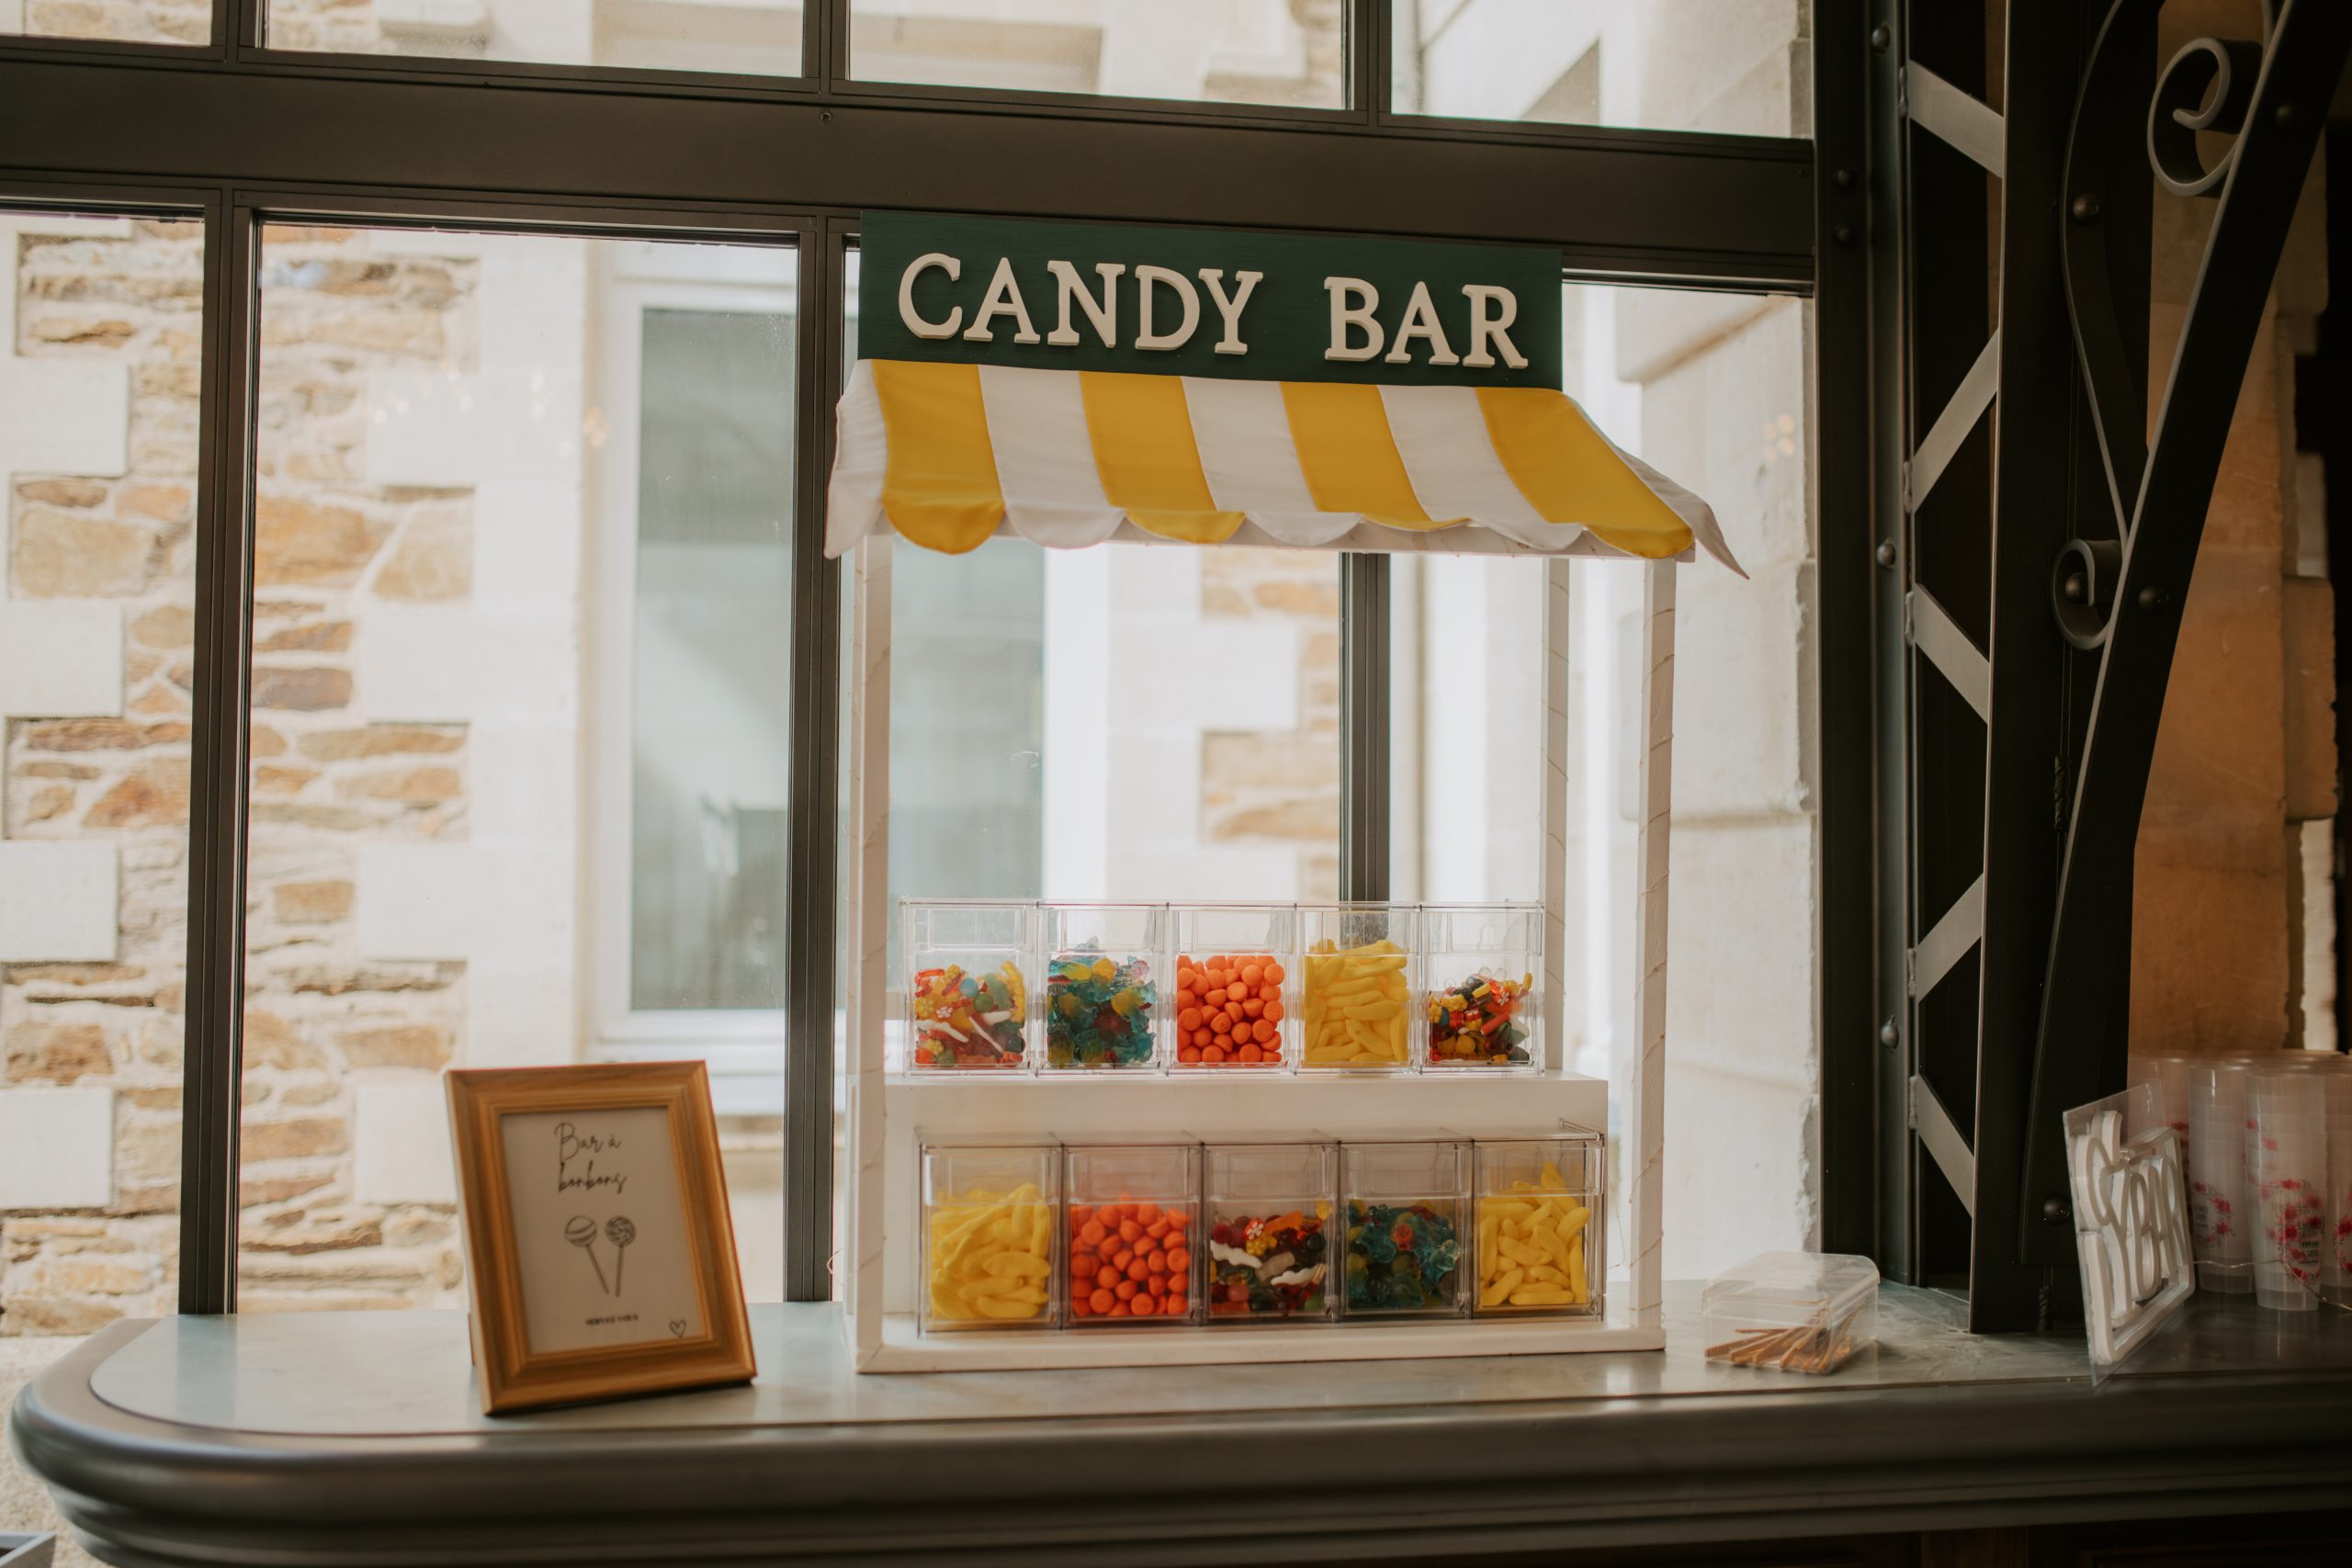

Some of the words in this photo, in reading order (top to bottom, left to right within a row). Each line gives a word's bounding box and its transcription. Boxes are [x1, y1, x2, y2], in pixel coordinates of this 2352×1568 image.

[898, 252, 1263, 355] CANDY
[1323, 276, 1529, 369] BAR
[553, 1122, 604, 1162] Bar
[558, 1159, 628, 1195] bonbons
